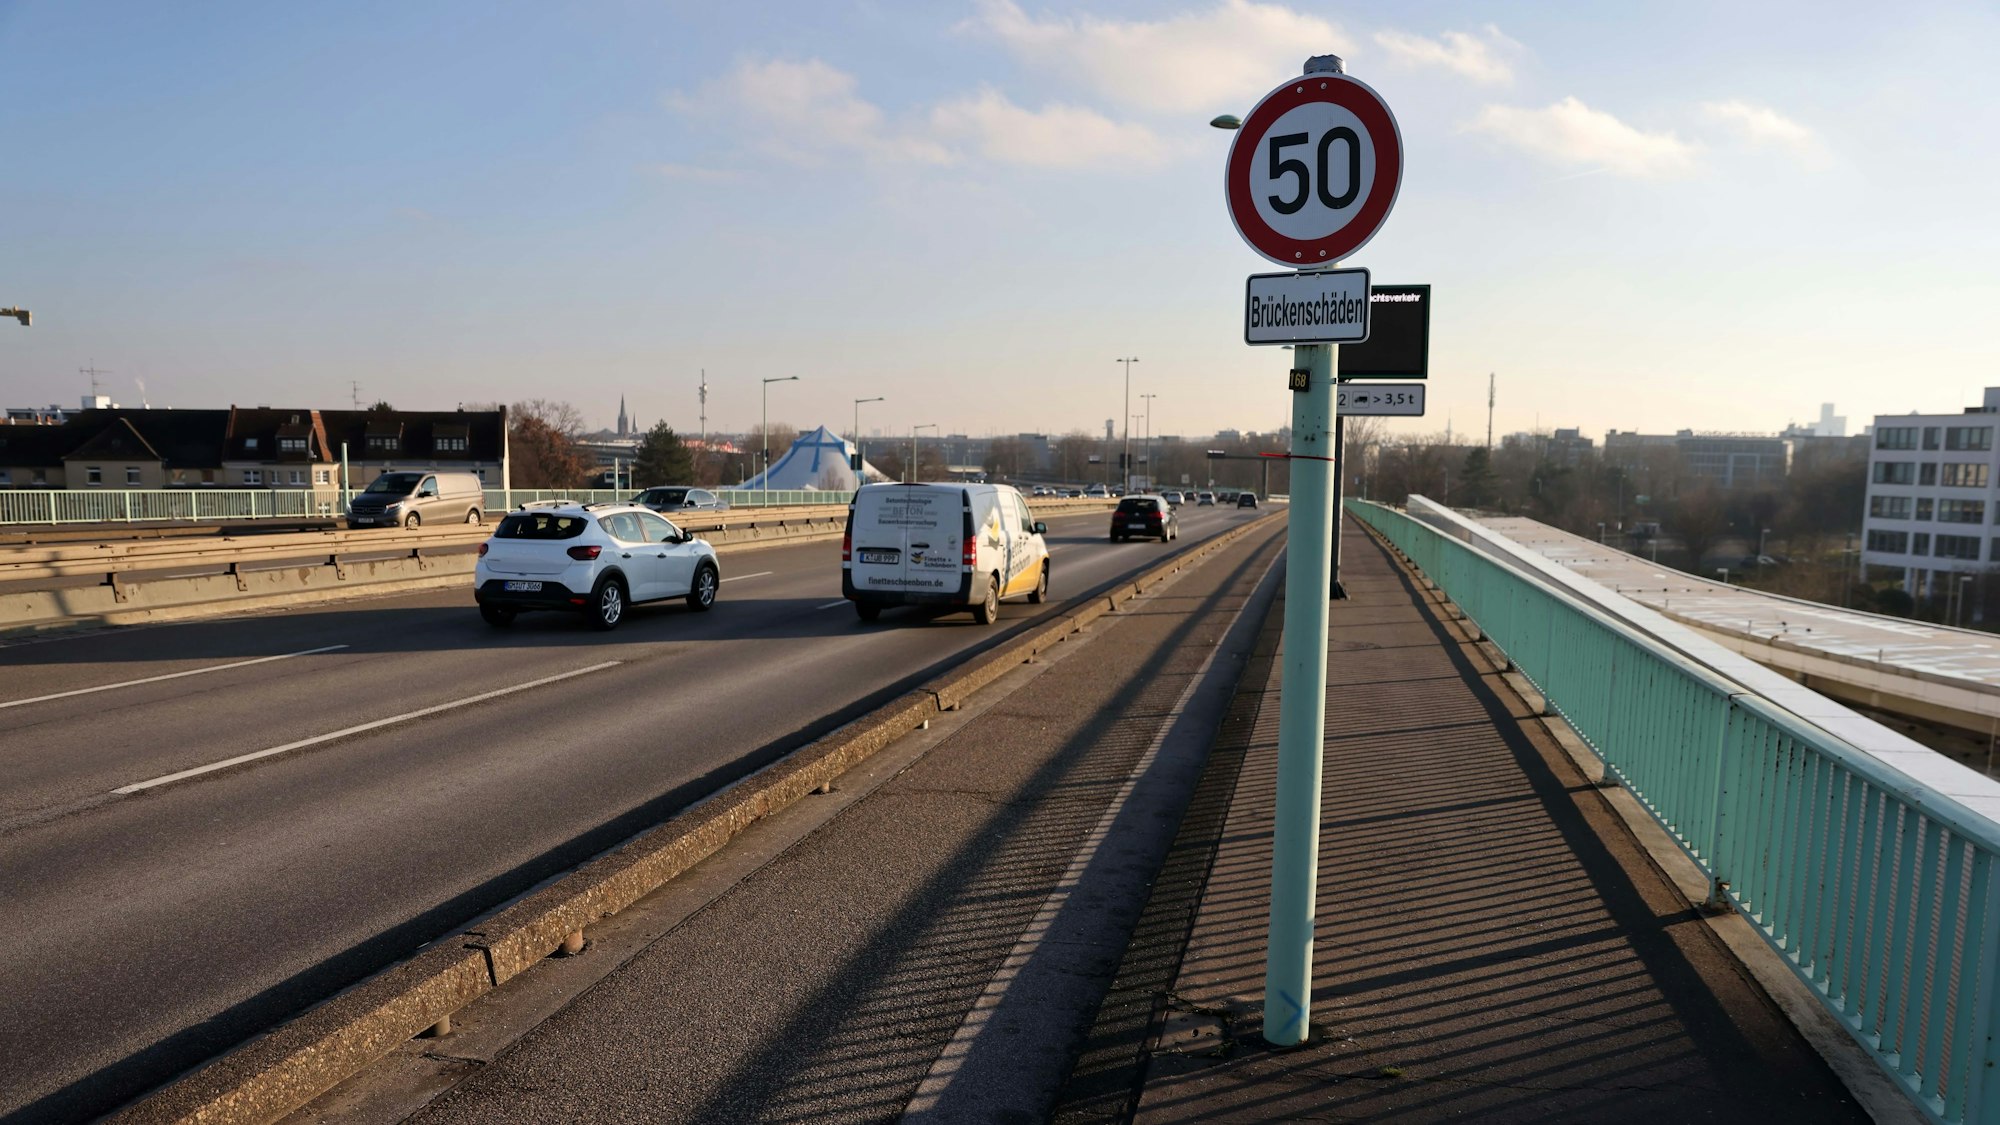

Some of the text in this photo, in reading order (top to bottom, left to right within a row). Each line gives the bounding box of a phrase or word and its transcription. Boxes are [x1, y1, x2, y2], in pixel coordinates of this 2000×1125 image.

[1268, 126, 1360, 215] 50
[1251, 290, 1363, 328] Brückenschäden
[1290, 372, 1306, 388] 168
[1385, 393, 1405, 406] 3,5
[1408, 394, 1414, 404] t
[892, 506, 923, 515] BETON
[868, 576, 943, 587] finetteschoenborn.de
